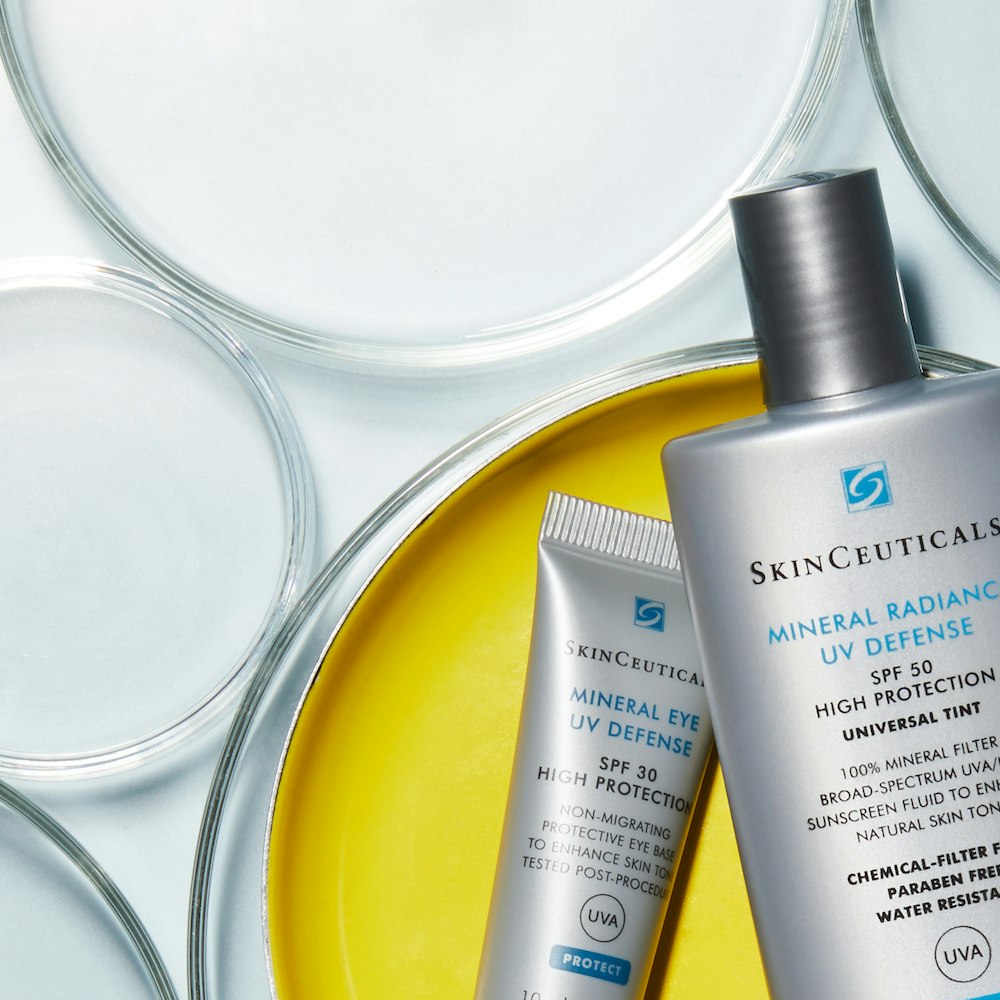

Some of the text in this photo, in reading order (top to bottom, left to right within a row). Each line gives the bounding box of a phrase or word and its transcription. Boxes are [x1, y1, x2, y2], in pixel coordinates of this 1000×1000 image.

[768, 608, 877, 645] MINERAL
[820, 616, 974, 666] UV DEFENSE
[871, 659, 933, 685] SPF 50
[570, 686, 700, 732] MINERAL EYE
[815, 667, 996, 718] HIGH PROTECTION
[570, 713, 693, 757] UV DEFENSE
[842, 701, 981, 741] UNIVERSAL TINT
[599, 756, 658, 782] SPF 30
[841, 735, 999, 780] 100% MINERAL FILTER
[537, 766, 693, 814] HIGH PROTECTION
[820, 768, 958, 807] BROAD-SPECTRUM
[560, 804, 671, 840] NON-MIGRATING
[807, 802, 897, 831] SUNSCREEN
[903, 793, 945, 812] FLUID
[948, 786, 971, 801] TO
[856, 819, 926, 843] NATURAL
[929, 810, 963, 828] SKIN
[528, 837, 674, 881] TO ENHANCE SKIN TON
[542, 820, 676, 862] PROTECTIVE EYE BASE
[522, 856, 669, 899] TESTED POST-PROCEDU
[847, 846, 987, 885] CHEMICAL-FILTER
[887, 874, 964, 900] PARABEN
[588, 909, 618, 928] UVA
[876, 902, 933, 924] WATER
[563, 953, 622, 977] PROTECT
[944, 944, 983, 965] UVA
